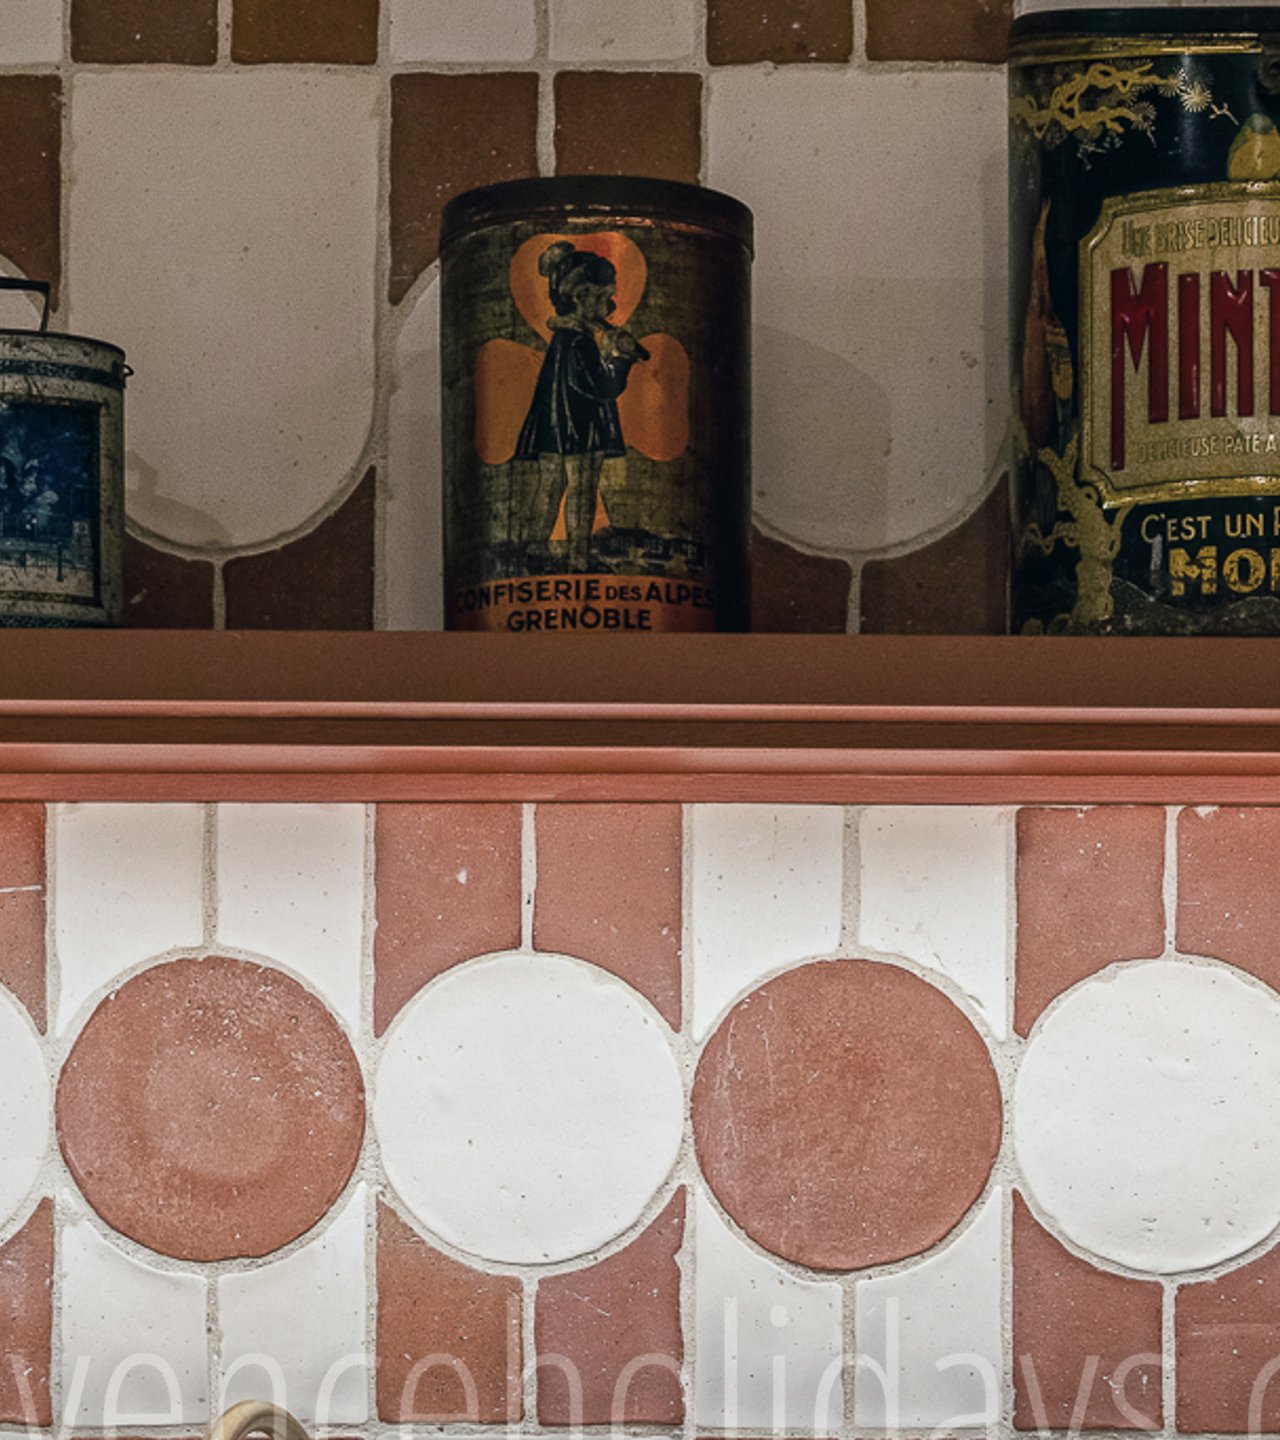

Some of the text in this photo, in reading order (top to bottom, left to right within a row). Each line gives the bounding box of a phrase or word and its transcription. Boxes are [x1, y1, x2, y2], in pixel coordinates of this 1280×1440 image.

[1140, 512, 1212, 543] C'EST
[1224, 512, 1265, 538] UN
[606, 585, 642, 602] DES
[645, 582, 714, 610] ALPES
[507, 607, 652, 631] GRENOBLE
